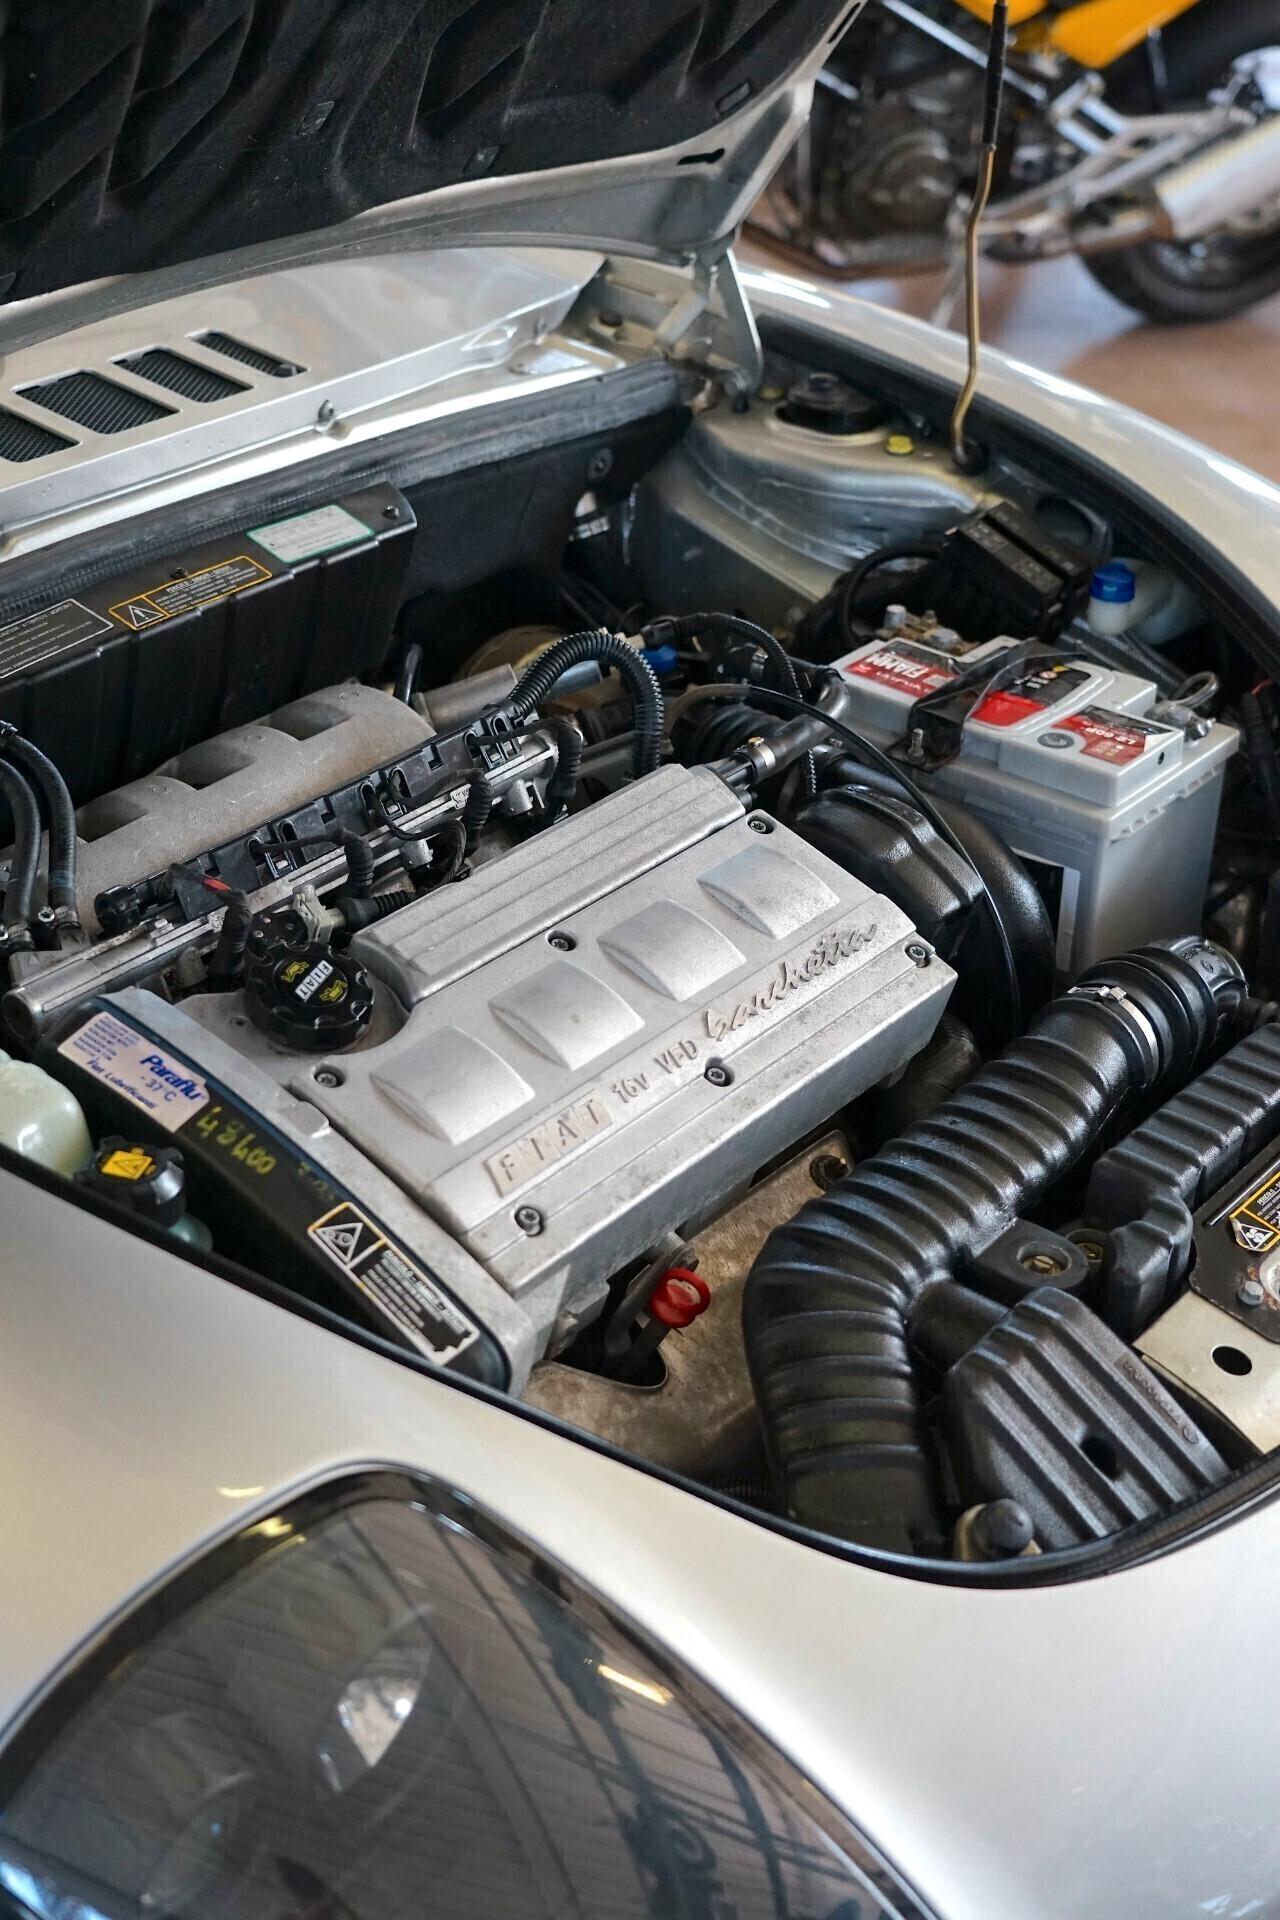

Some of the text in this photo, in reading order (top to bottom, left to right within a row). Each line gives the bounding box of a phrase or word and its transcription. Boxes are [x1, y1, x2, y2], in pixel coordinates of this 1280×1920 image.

[864, 651, 930, 679] FIAMM
[297, 962, 333, 1000] FIAT
[139, 1054, 202, 1101] Paraflu
[499, 1099, 600, 1181] FIAT
